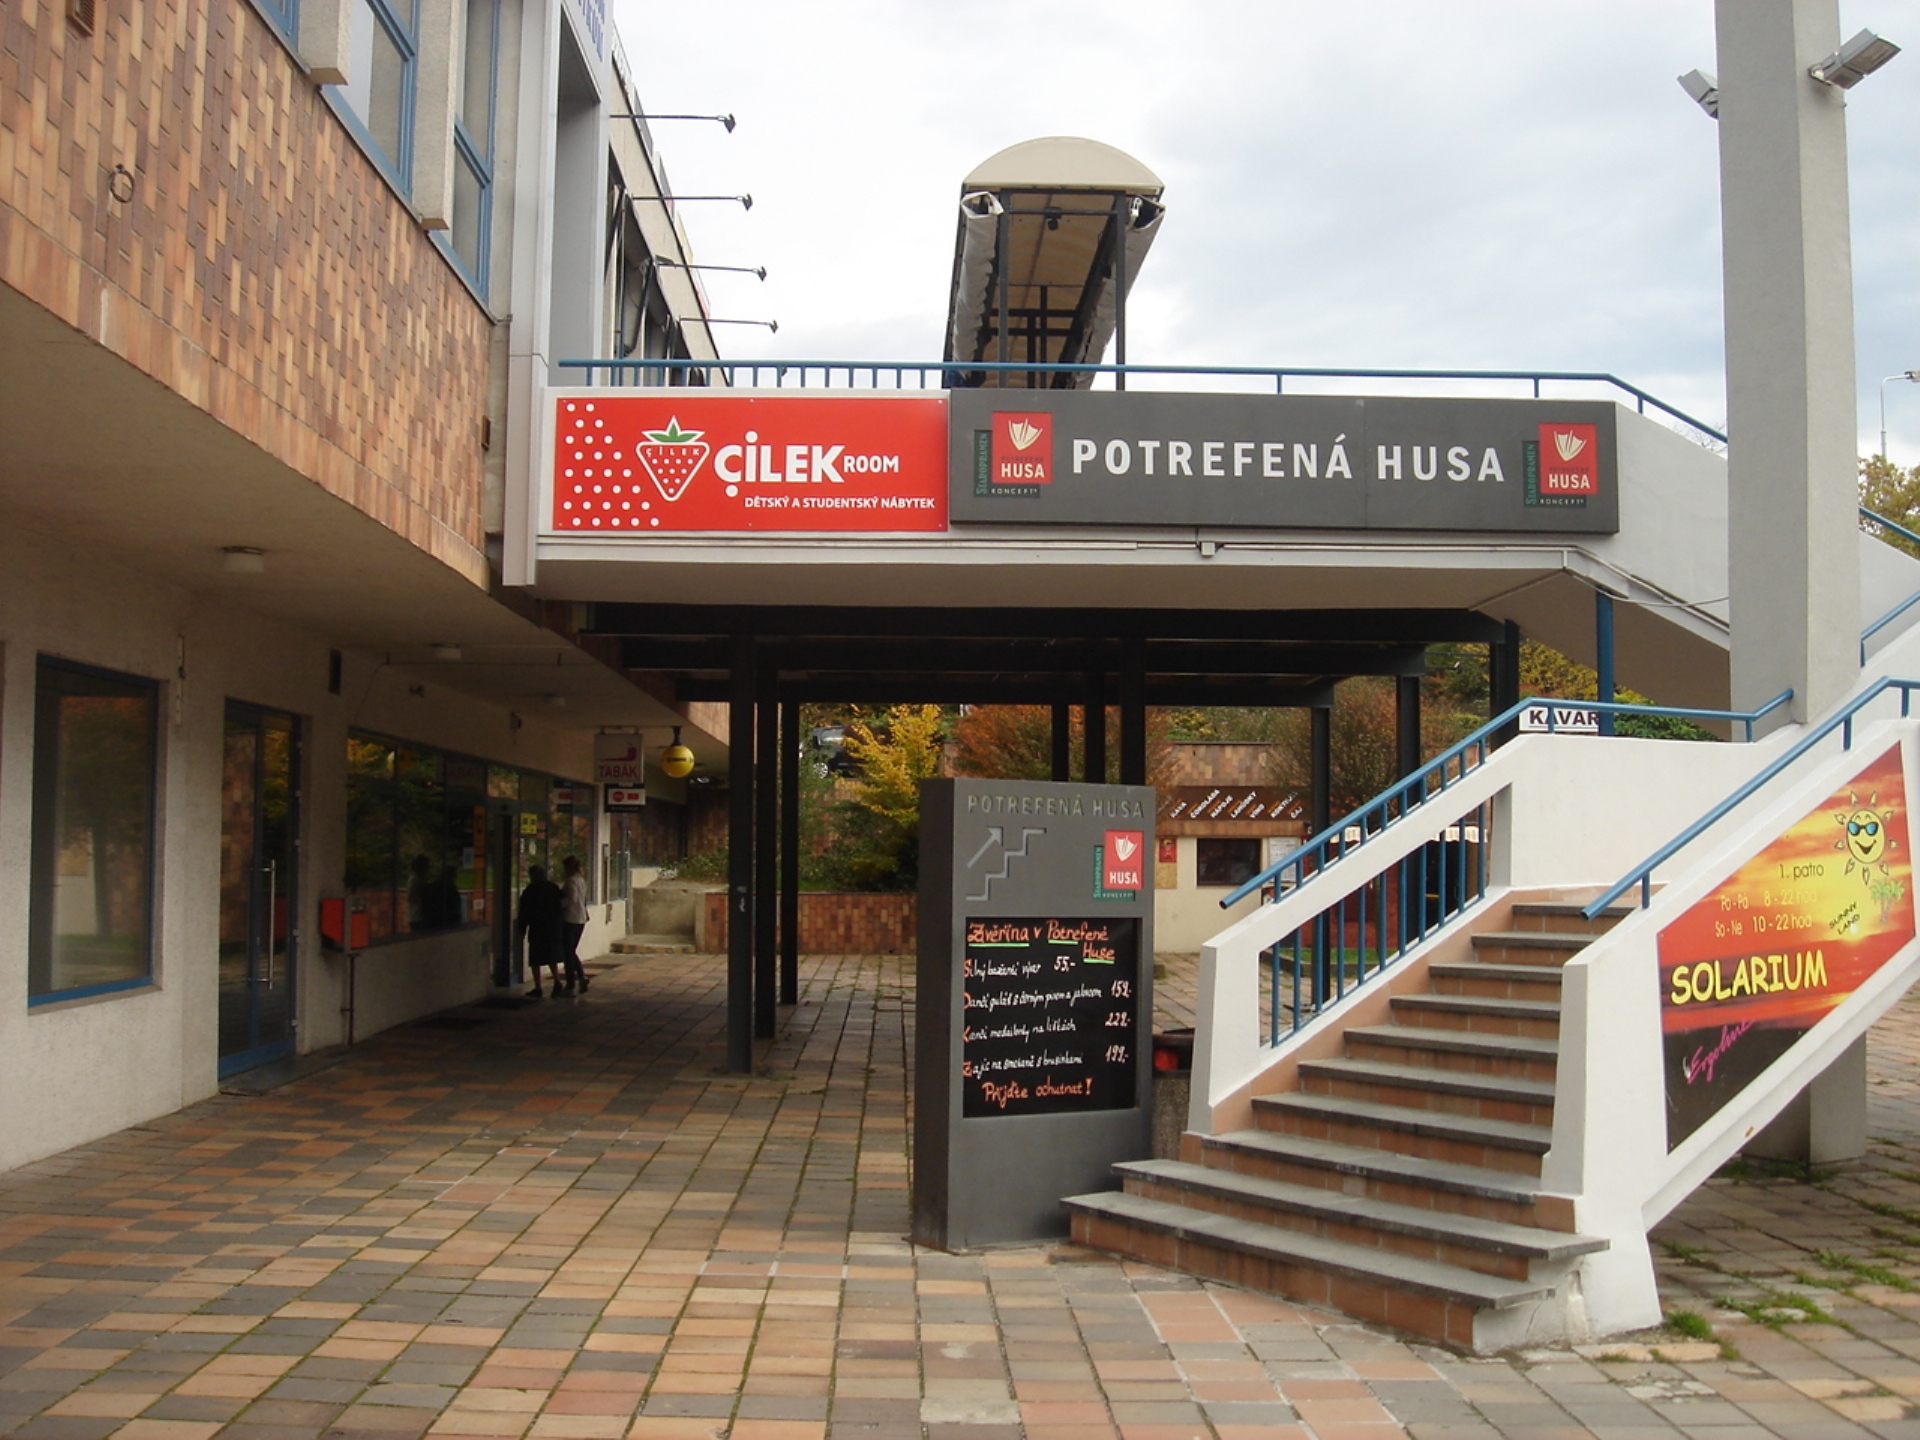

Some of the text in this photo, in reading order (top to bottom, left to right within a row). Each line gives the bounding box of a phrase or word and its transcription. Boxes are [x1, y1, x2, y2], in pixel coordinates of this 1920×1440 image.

[843, 455, 899, 473] ROOM
[1073, 434, 1505, 482] POTREFENÁ HUSA
[1001, 463, 1045, 478] HUSA
[1548, 473, 1591, 489] HUSA
[744, 496, 935, 508] DĚTSKÝ A STUDENTSKÝ NÁBYTEK
[598, 763, 638, 778] TABÁK
[967, 793, 1084, 816] POTREFENÁ
[1092, 799, 1144, 817] HUSA
[1109, 871, 1138, 884] HUSA
[1793, 862, 1824, 881] patro
[1764, 891, 1771, 907] 8
[1781, 890, 1793, 905] 22
[1752, 916, 1766, 932] 10
[1776, 914, 1789, 931] 22
[1791, 913, 1813, 929] hod
[1829, 901, 1858, 929] SUNNY
[1837, 913, 1861, 935] LAND
[1083, 942, 1115, 959] Huse
[1670, 949, 1828, 1005] SOLARIUM
